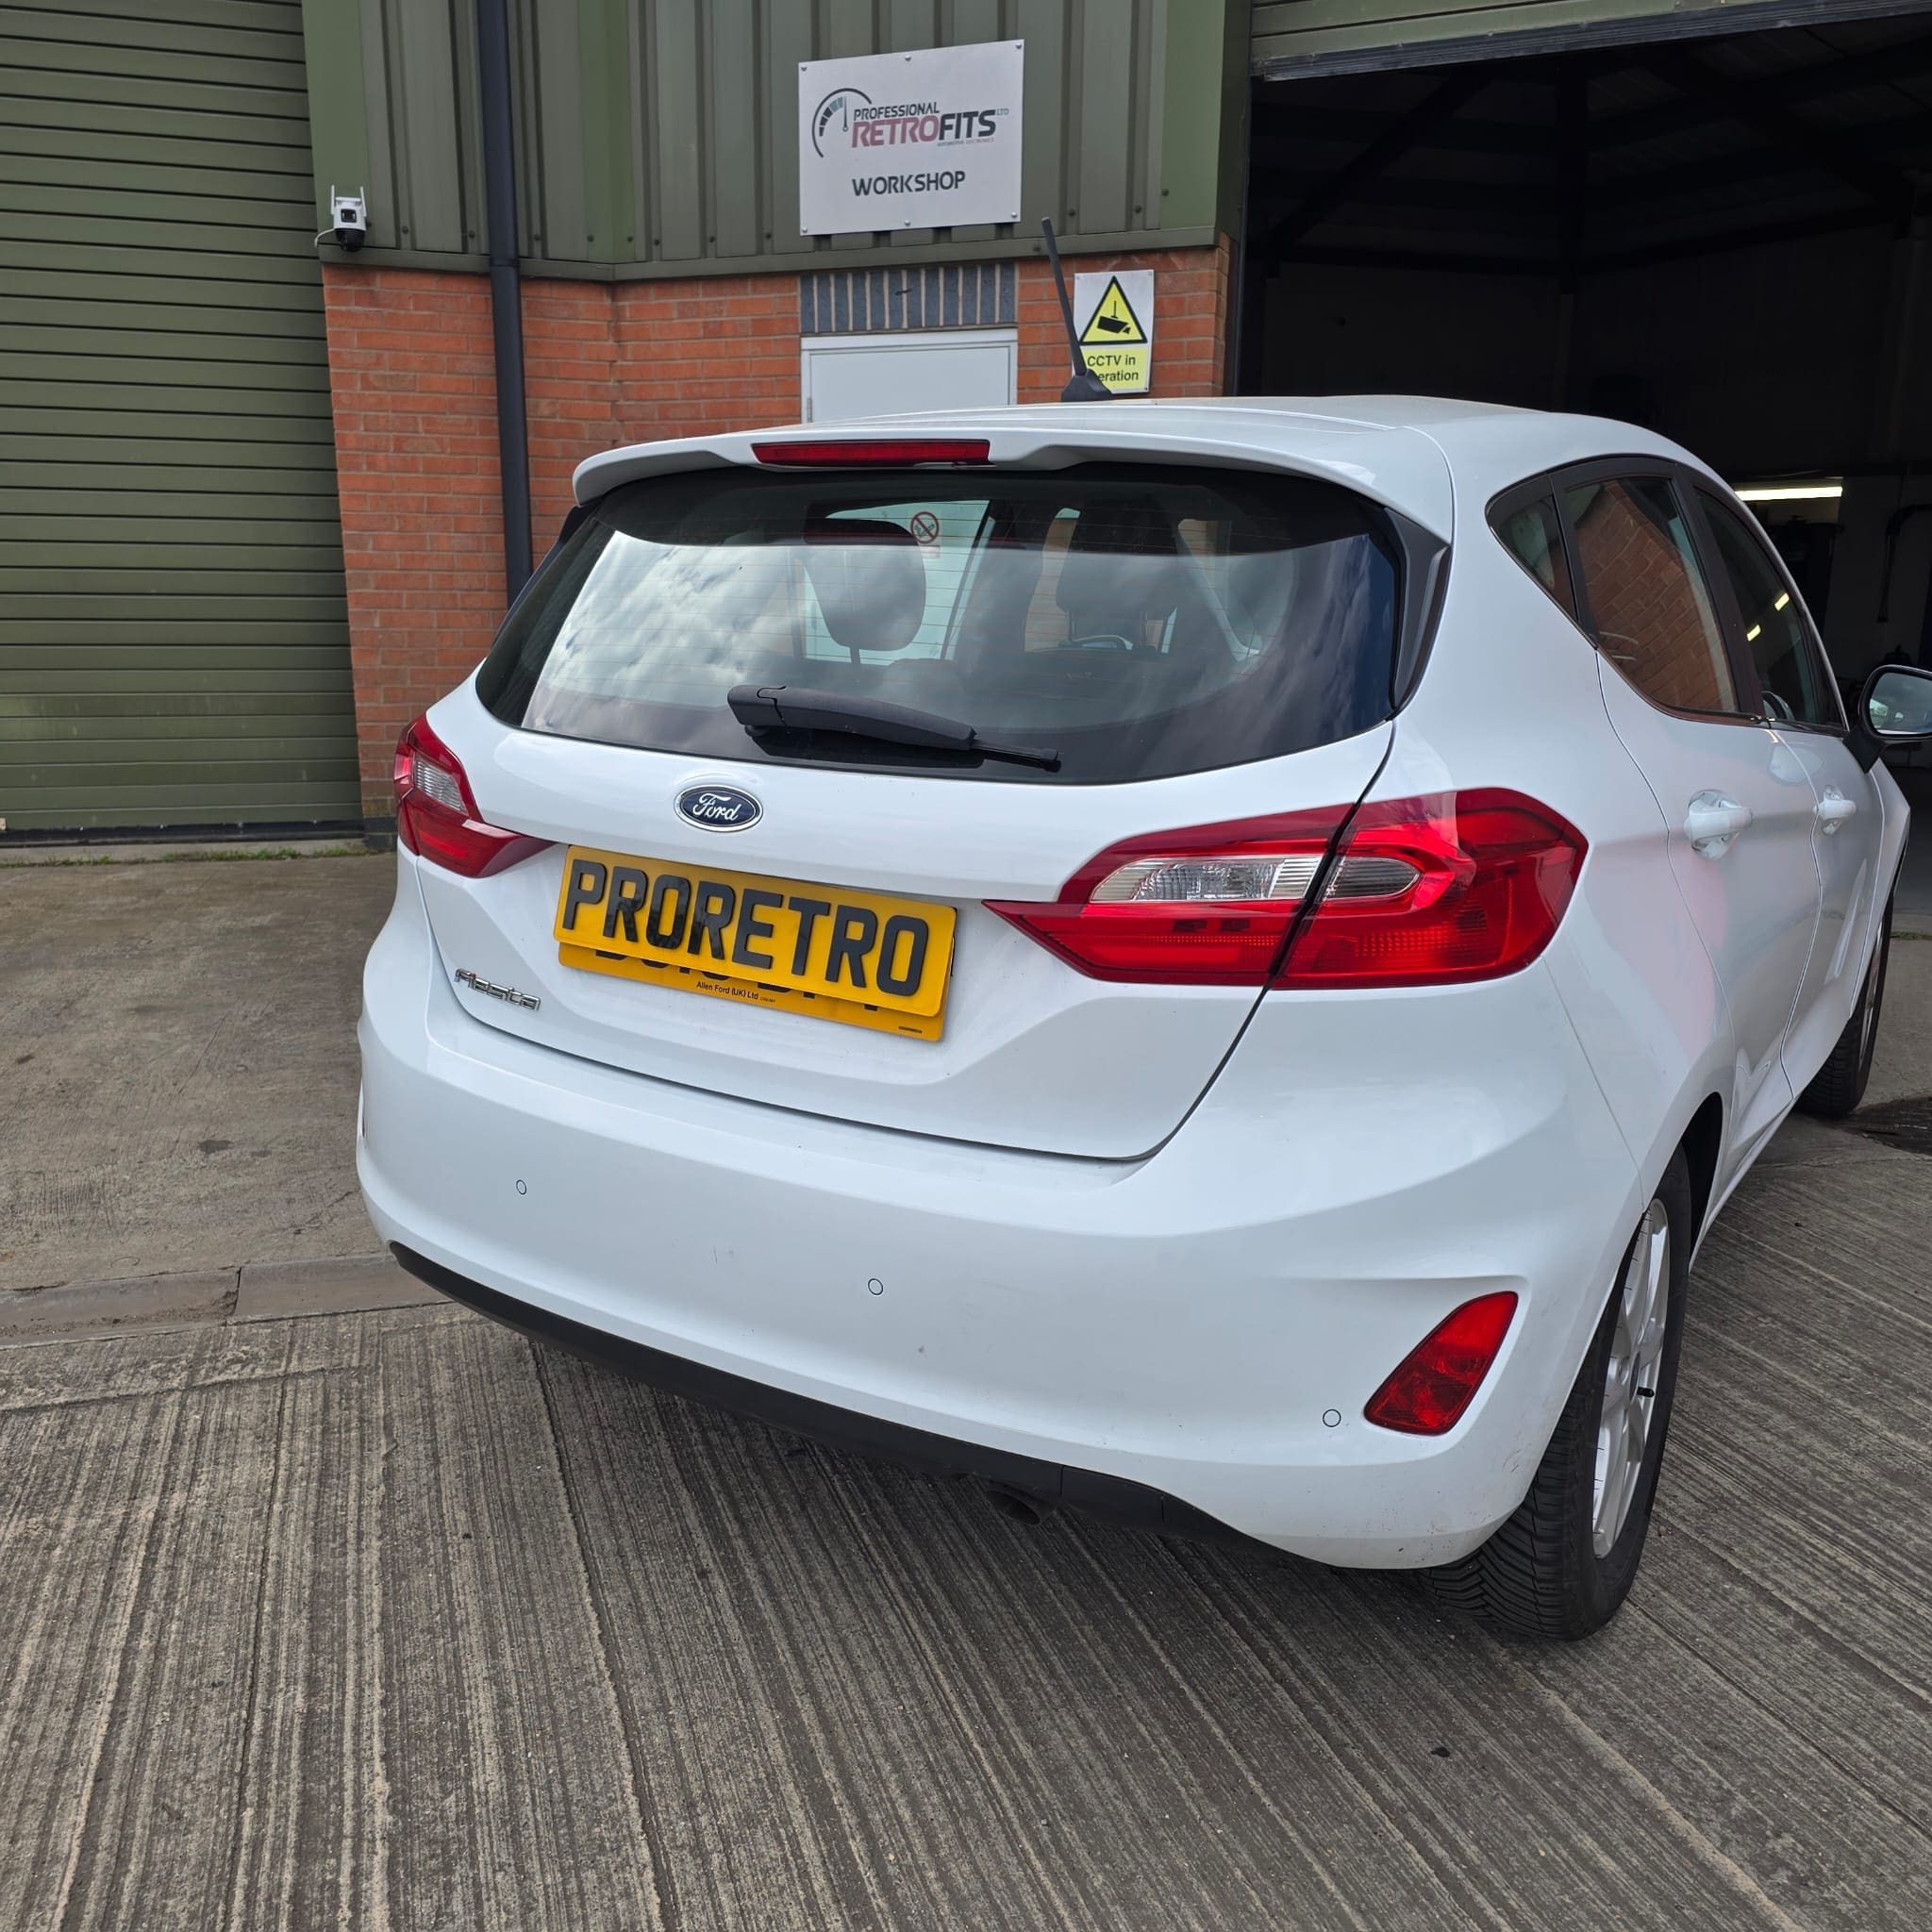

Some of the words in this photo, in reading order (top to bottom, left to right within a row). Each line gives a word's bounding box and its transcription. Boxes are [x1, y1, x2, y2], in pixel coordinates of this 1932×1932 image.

[854, 102, 940, 122] PROFESSIONAL
[851, 109, 996, 148] RETROFITS
[852, 171, 966, 197] WORKSHOP
[1087, 355, 1122, 367] CCTV
[1125, 355, 1136, 366] in
[1098, 371, 1139, 382] eration
[691, 792, 743, 824] Ford
[562, 858, 928, 997] PRORETRO
[697, 981, 713, 991] Allen
[714, 985, 730, 994] Ford
[732, 988, 746, 997] (UK)
[747, 991, 758, 1000] Ltd
